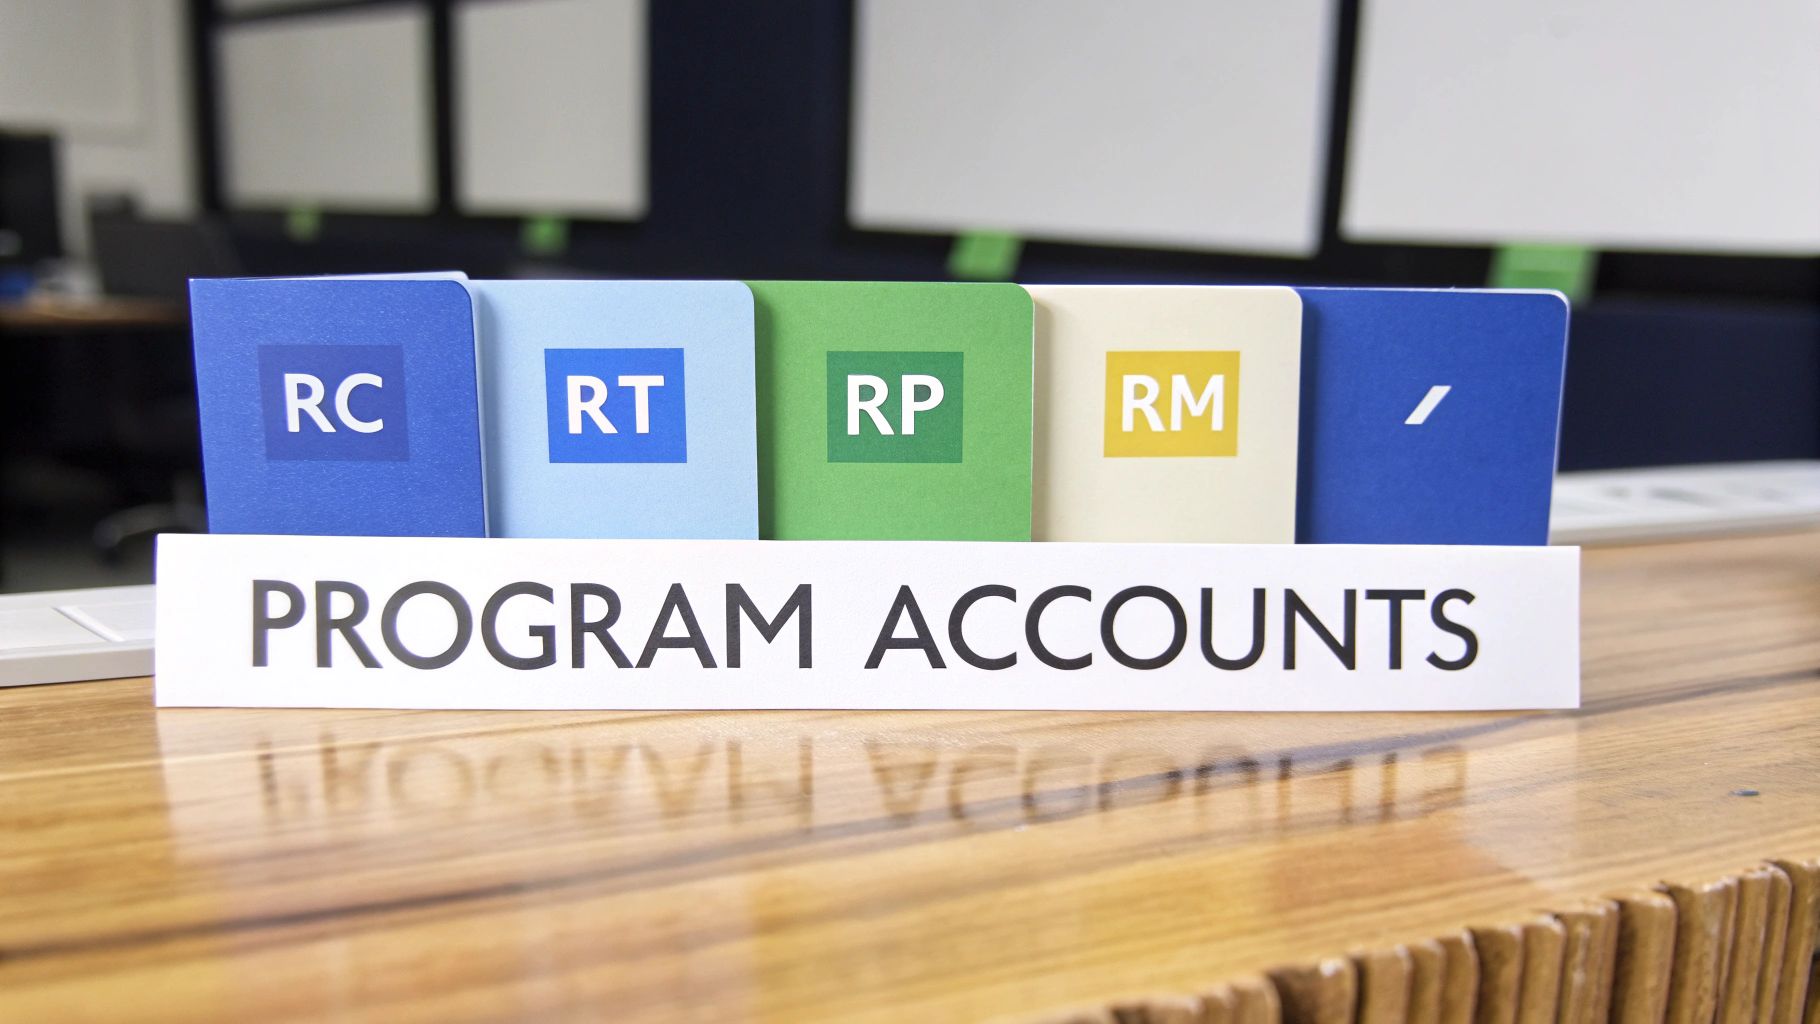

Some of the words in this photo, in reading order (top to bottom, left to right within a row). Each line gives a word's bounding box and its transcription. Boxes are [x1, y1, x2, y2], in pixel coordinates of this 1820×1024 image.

[284, 372, 384, 434] RC
[566, 375, 665, 435] RT
[847, 374, 945, 436] RP
[1120, 374, 1225, 432] RM
[252, 579, 813, 671] PROGRAM
[864, 584, 1479, 671] ACCOUNTS
